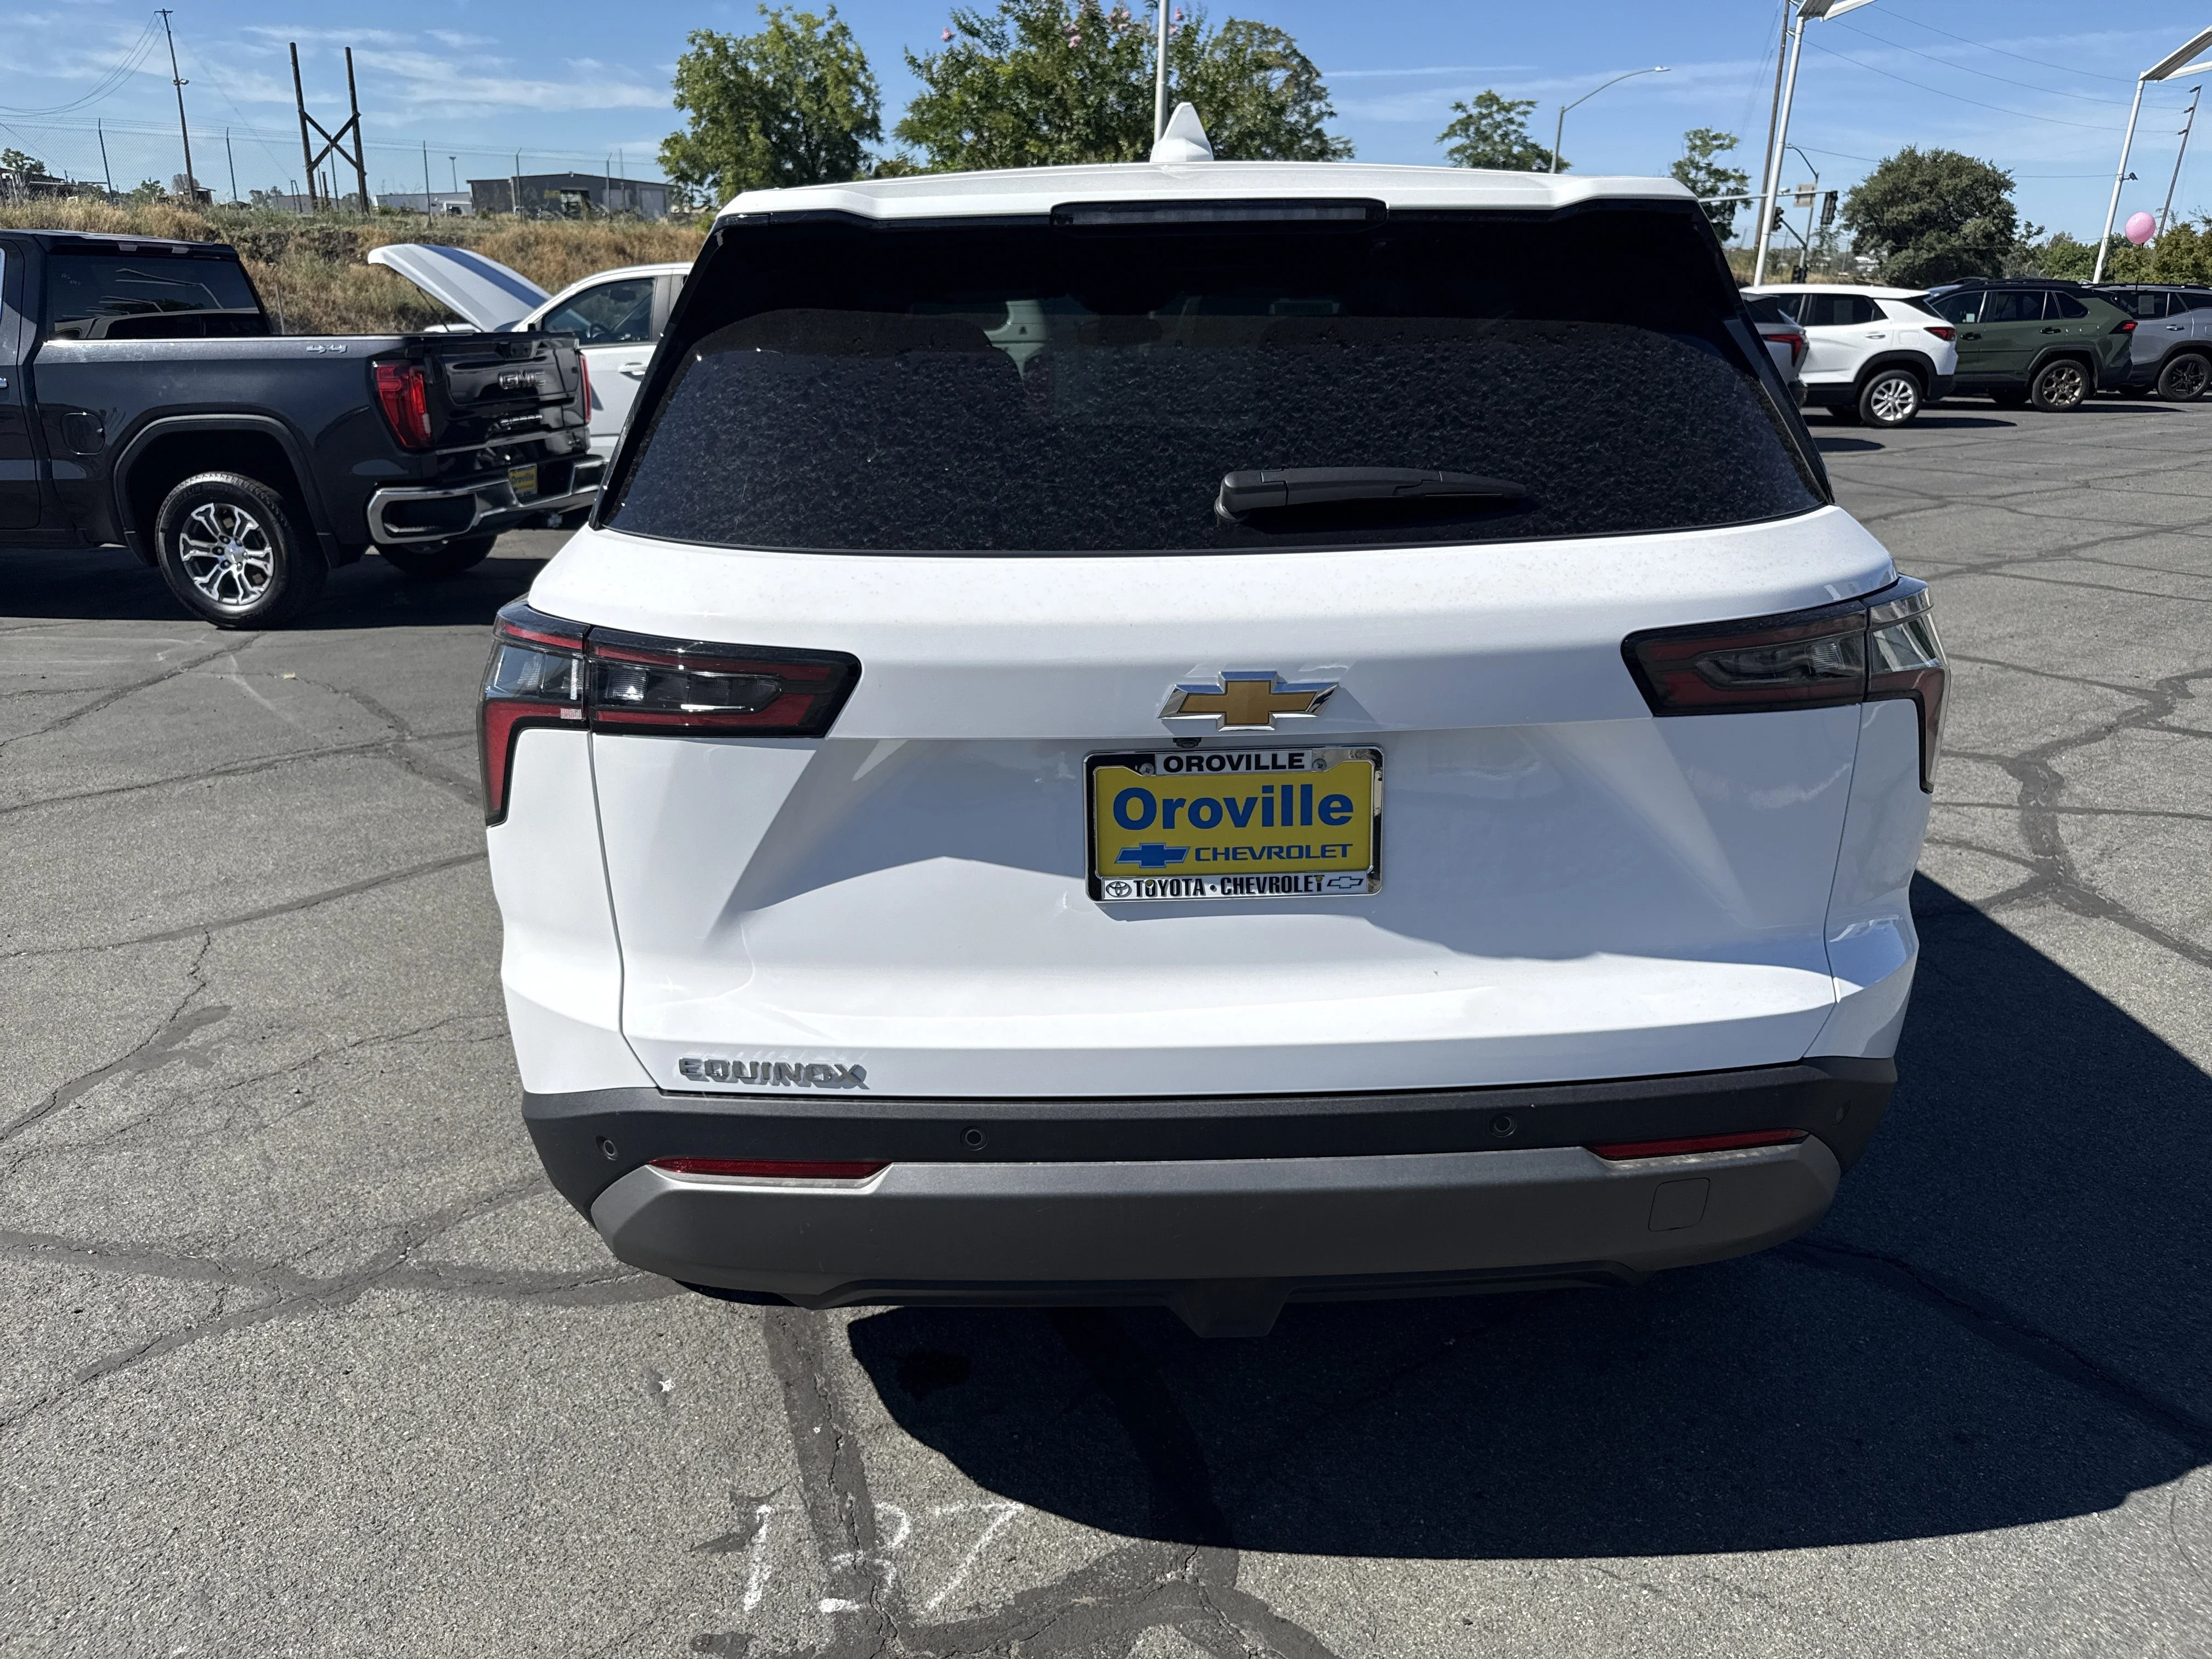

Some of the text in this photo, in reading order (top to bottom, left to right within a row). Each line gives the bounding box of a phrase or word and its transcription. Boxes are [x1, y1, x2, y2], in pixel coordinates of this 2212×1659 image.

[498, 371, 546, 389] GMC
[511, 473, 535, 484] Oroville
[1163, 752, 1305, 773] OROVILLE
[1113, 783, 1354, 831] Oroville
[1194, 843, 1354, 862] CHEVROLET
[1133, 874, 1324, 897] TOYOTA CHEVROLET
[679, 1056, 865, 1084] EQUINOX
